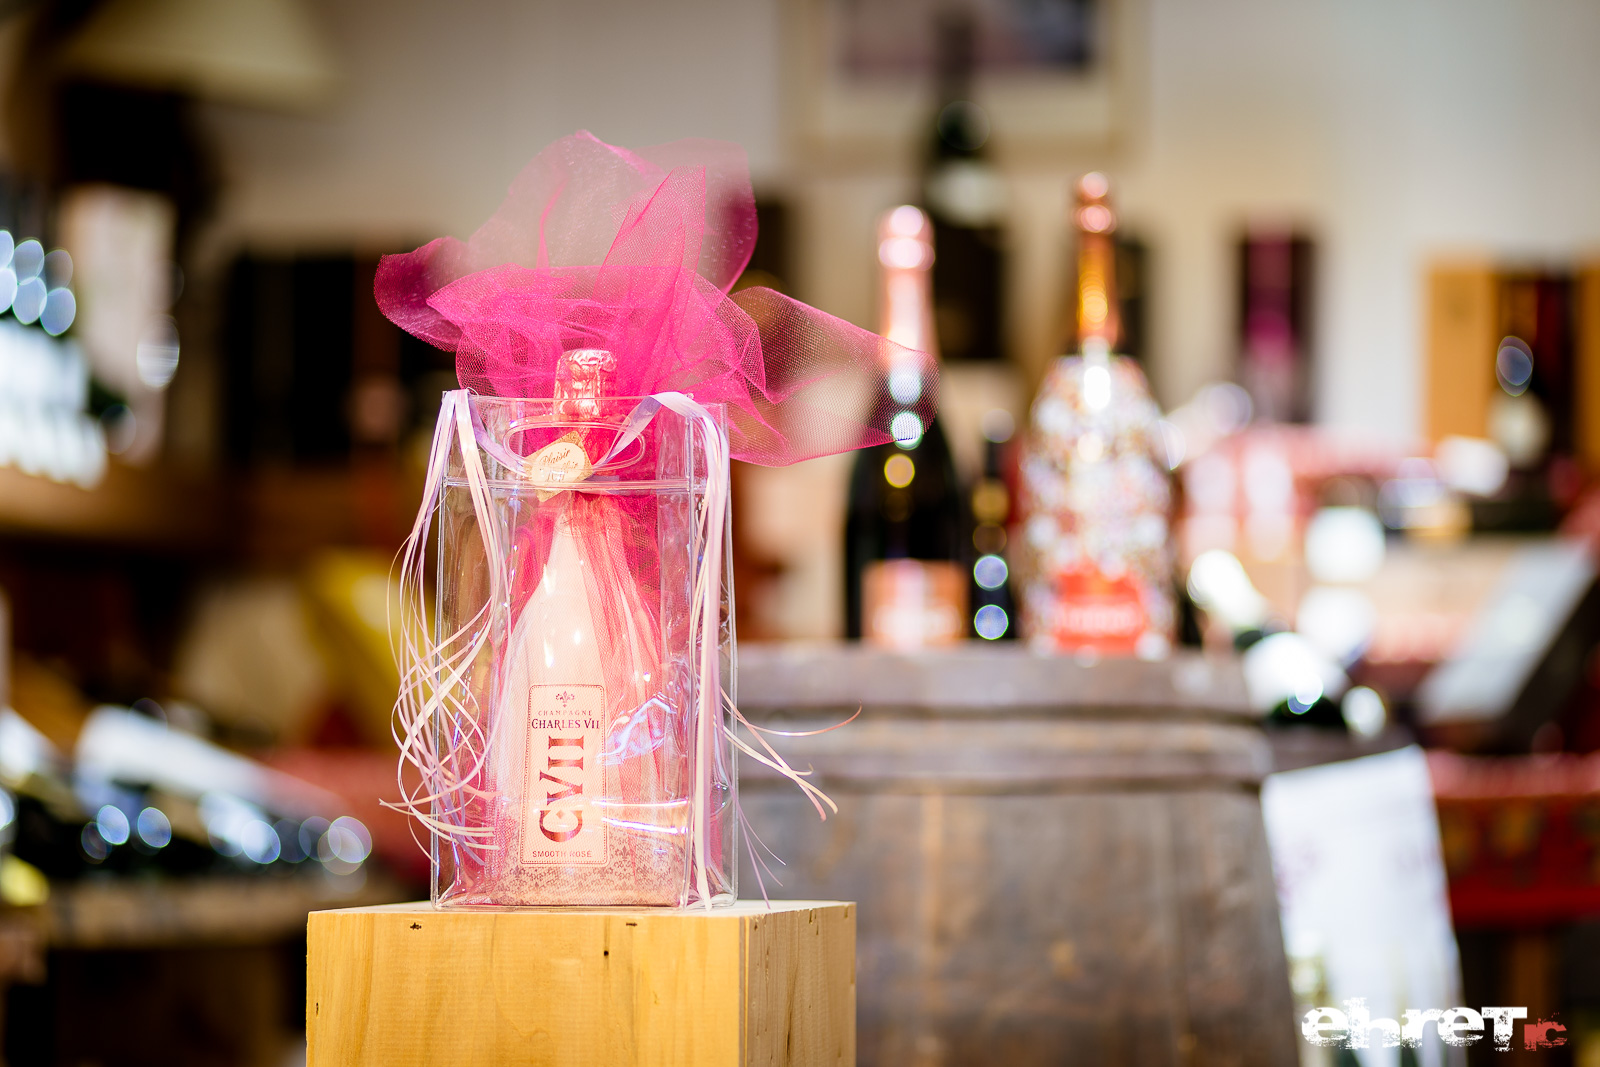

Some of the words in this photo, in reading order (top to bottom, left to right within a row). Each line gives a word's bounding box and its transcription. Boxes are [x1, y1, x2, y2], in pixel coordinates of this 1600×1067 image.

[537, 709, 593, 717] CHAMPAGNE
[531, 718, 581, 730] CHARLES
[584, 717, 600, 729] VII
[532, 850, 566, 858] SMOOTH
[569, 849, 592, 858] ROSÉ
